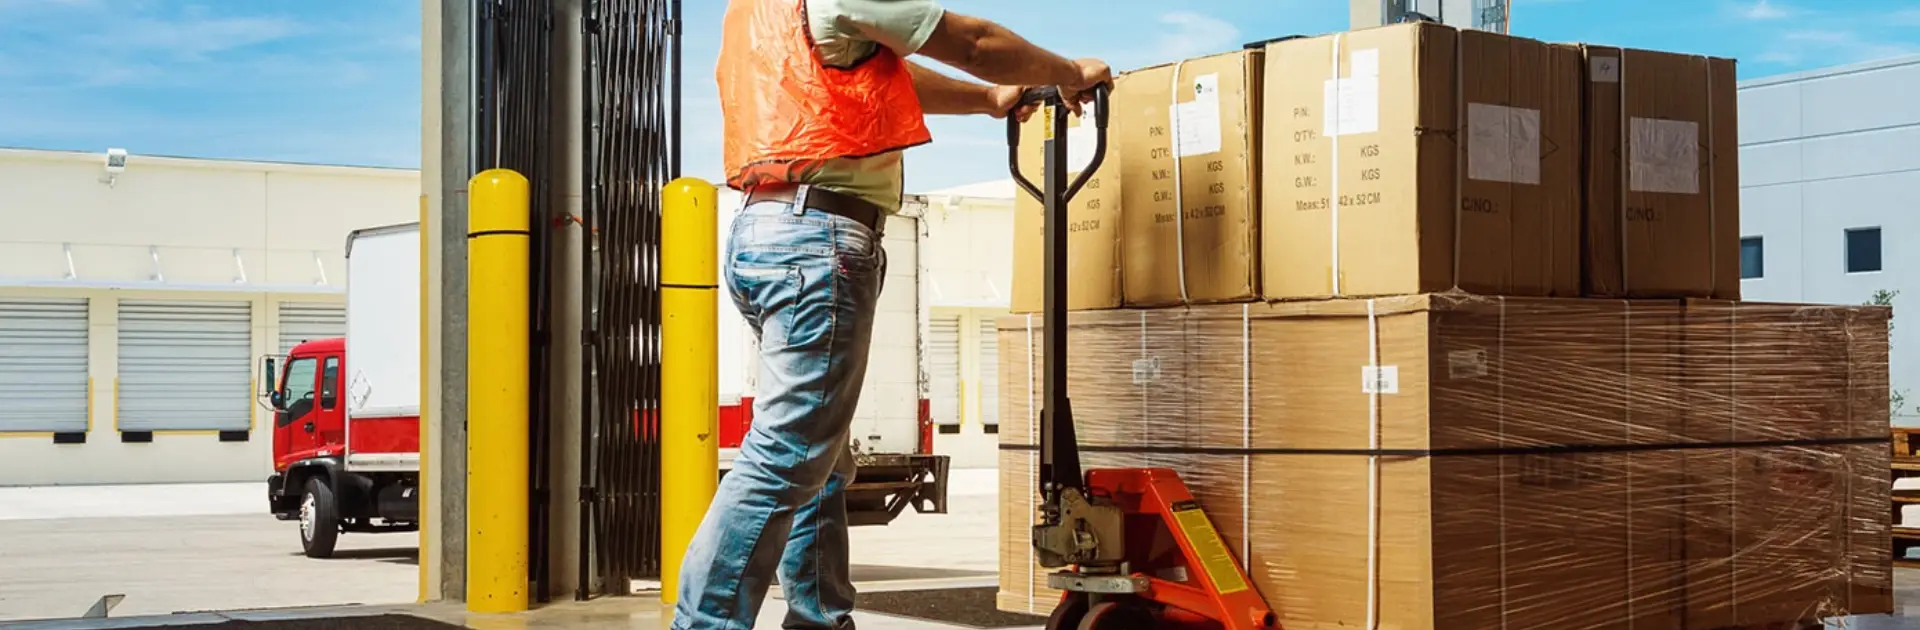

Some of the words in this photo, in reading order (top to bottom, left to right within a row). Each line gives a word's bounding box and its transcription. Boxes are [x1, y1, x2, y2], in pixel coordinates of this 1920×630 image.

[1361, 144, 1380, 158] KGS
[1207, 160, 1223, 172] KGS
[1361, 168, 1380, 181] KGS
[1208, 182, 1224, 194] KGS
[1367, 192, 1381, 204] CM
